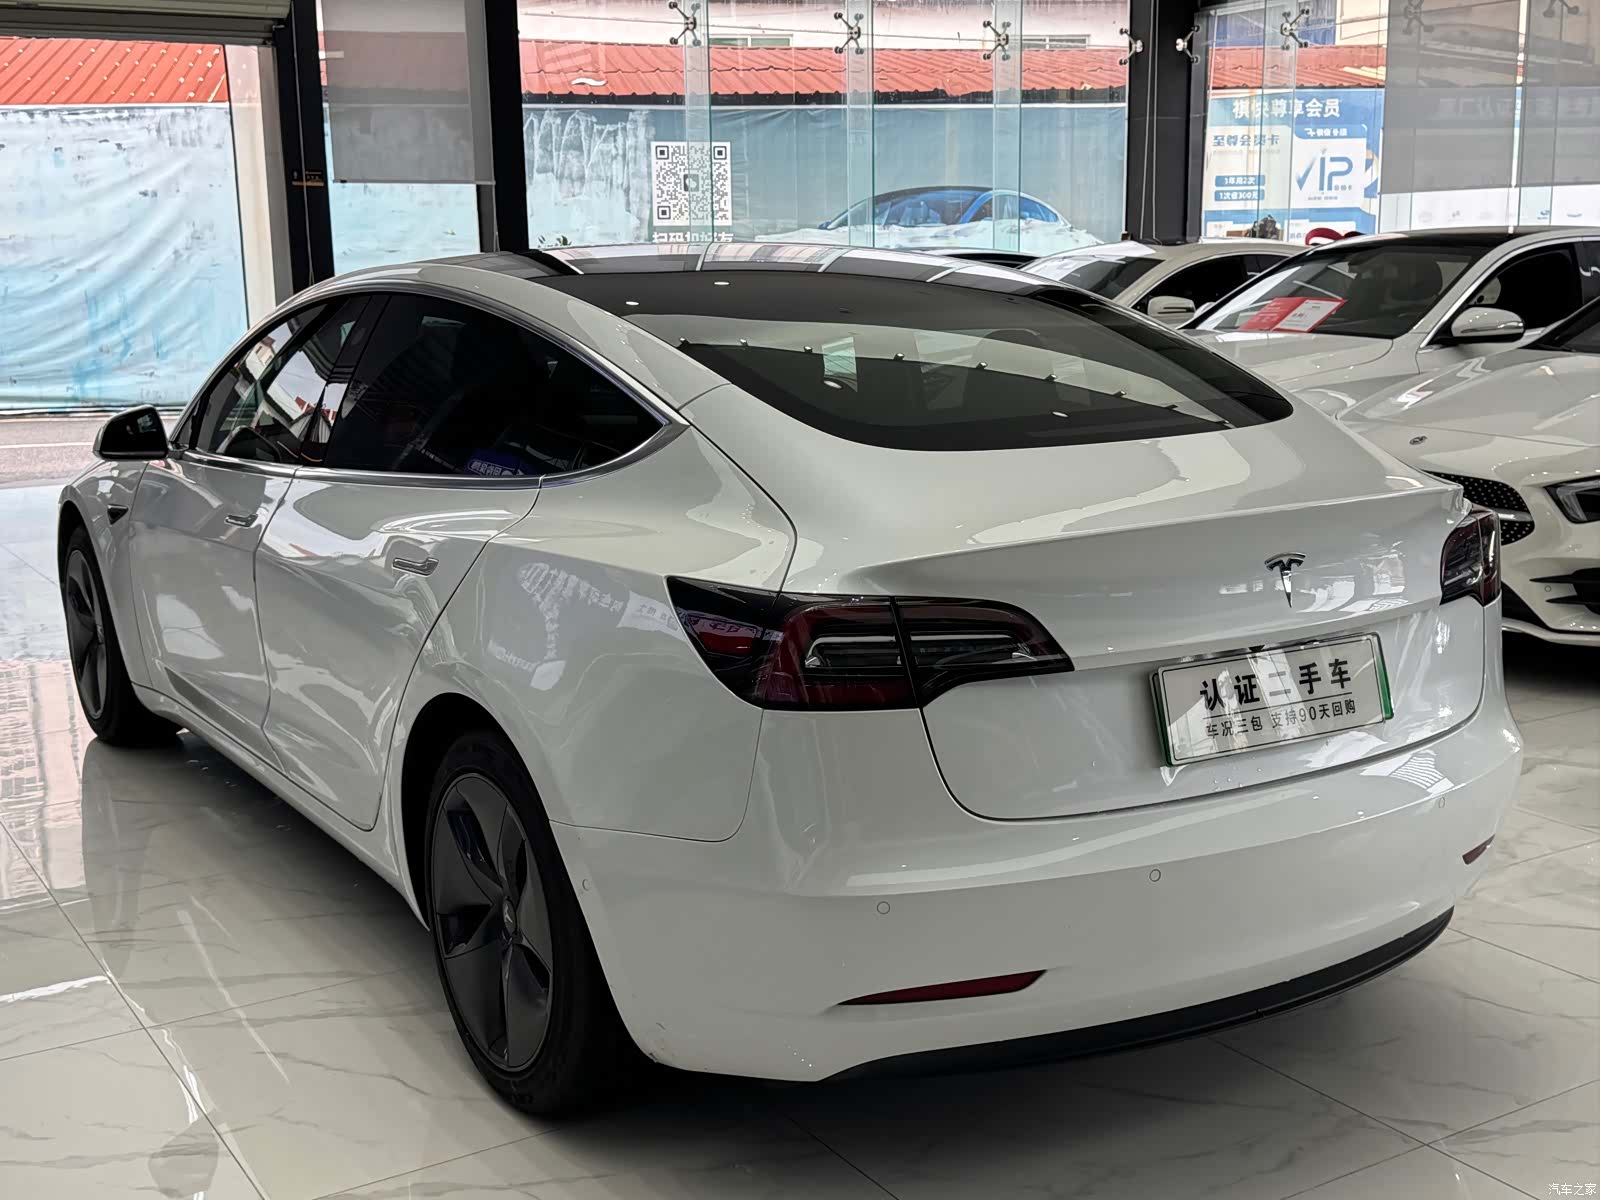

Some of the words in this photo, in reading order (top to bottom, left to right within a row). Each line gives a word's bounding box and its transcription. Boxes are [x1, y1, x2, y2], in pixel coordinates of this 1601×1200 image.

[1200, 658, 1351, 711] 认证二手车
[1206, 715, 1263, 739] 车况三包
[1271, 699, 1357, 729] 支持90天回购
